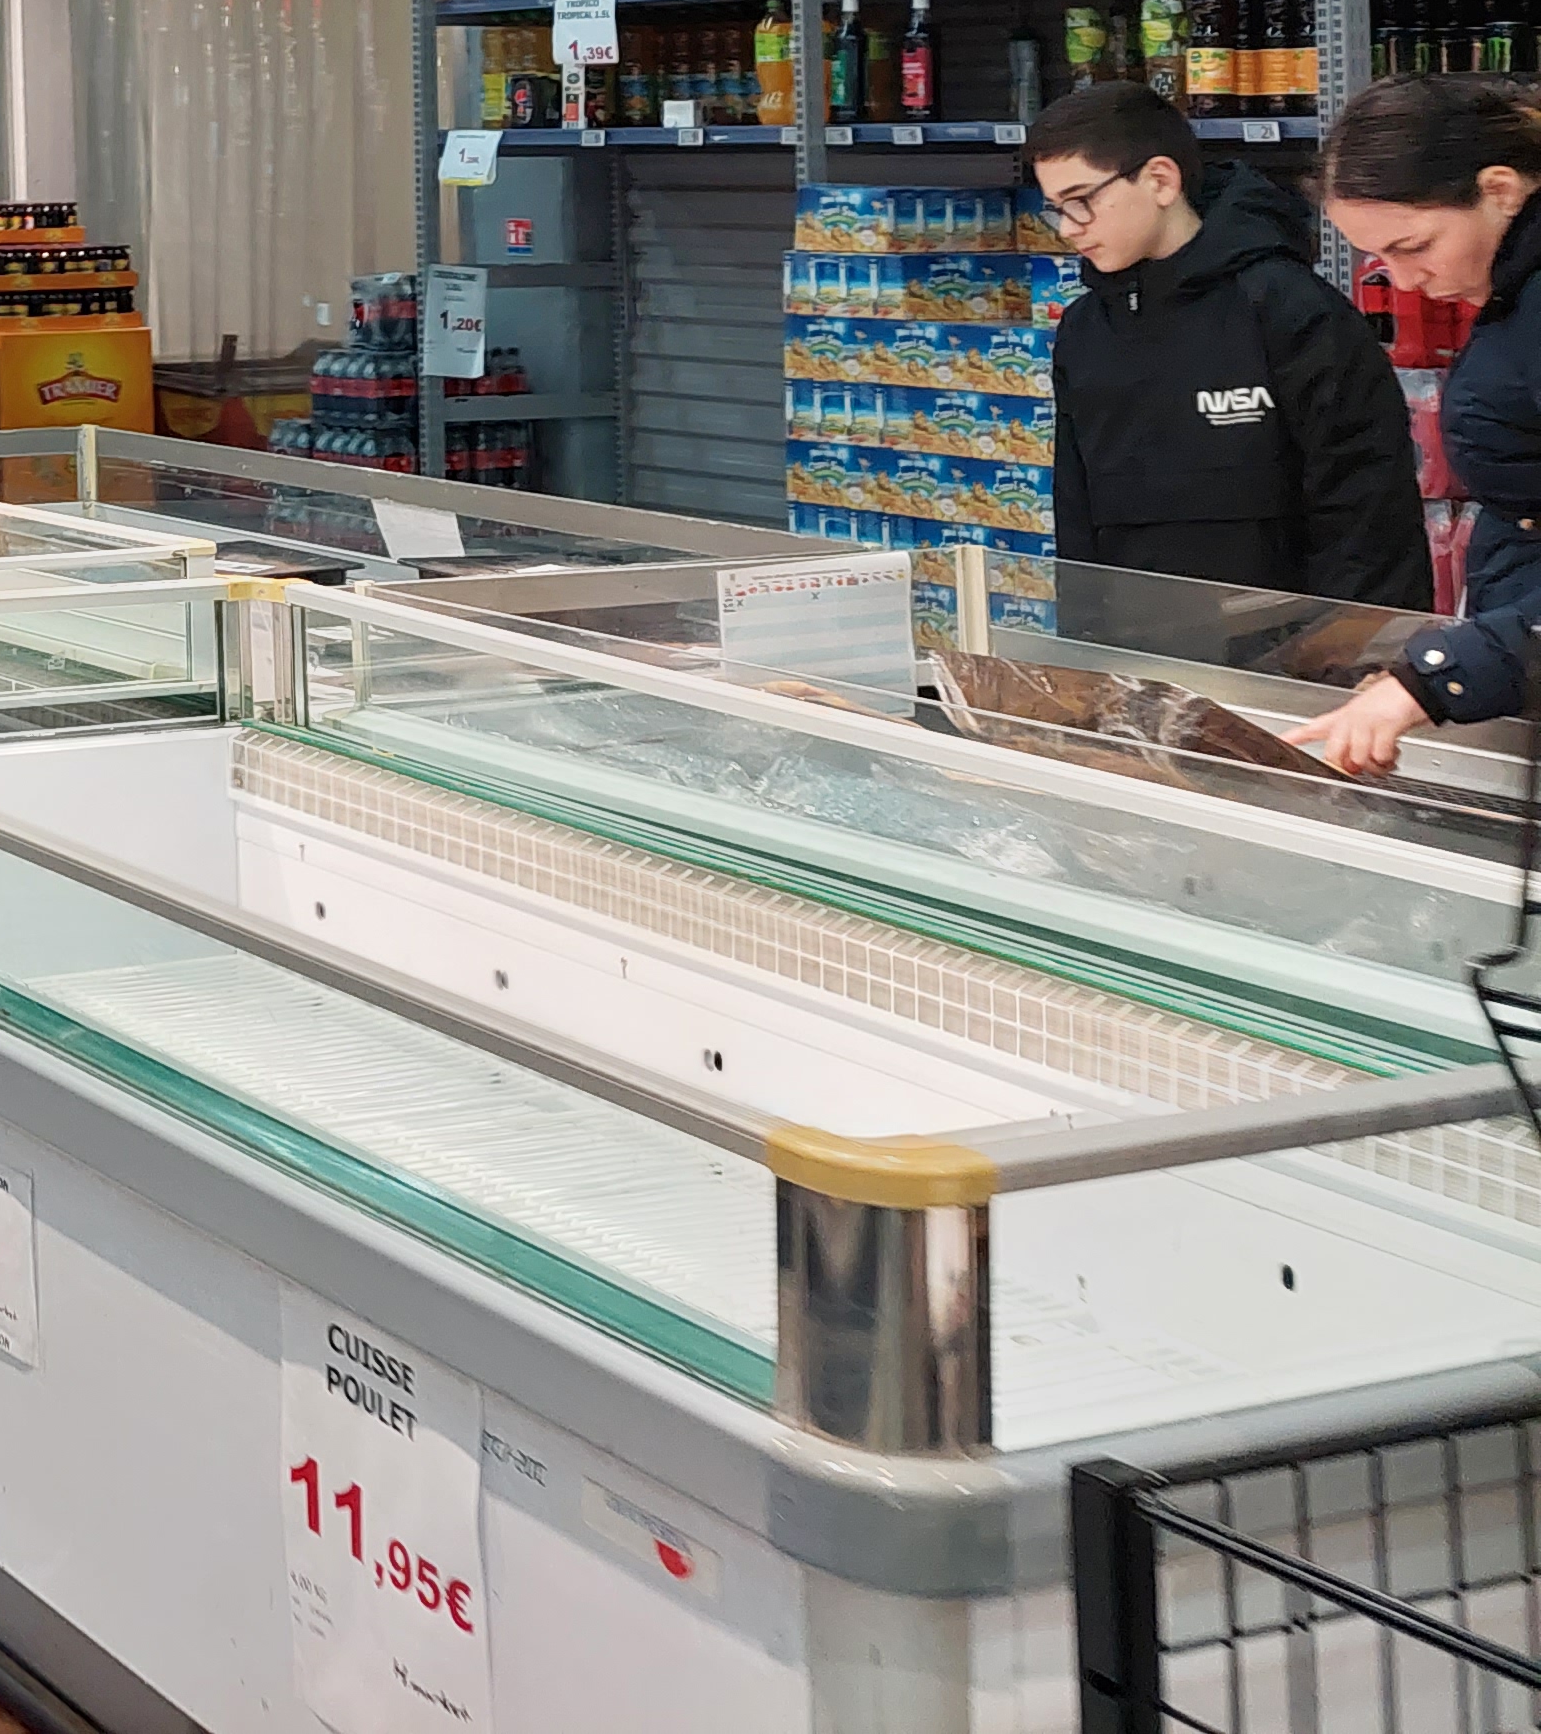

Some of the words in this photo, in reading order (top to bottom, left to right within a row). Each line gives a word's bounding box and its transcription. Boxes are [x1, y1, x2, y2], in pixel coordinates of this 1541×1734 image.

[568, 39, 614, 62] 1,39€
[1197, 386, 1276, 413] NASA
[327, 1323, 416, 1397] CUISSE
[325, 1363, 418, 1442] POULET
[290, 1454, 476, 1635] 11,95€
